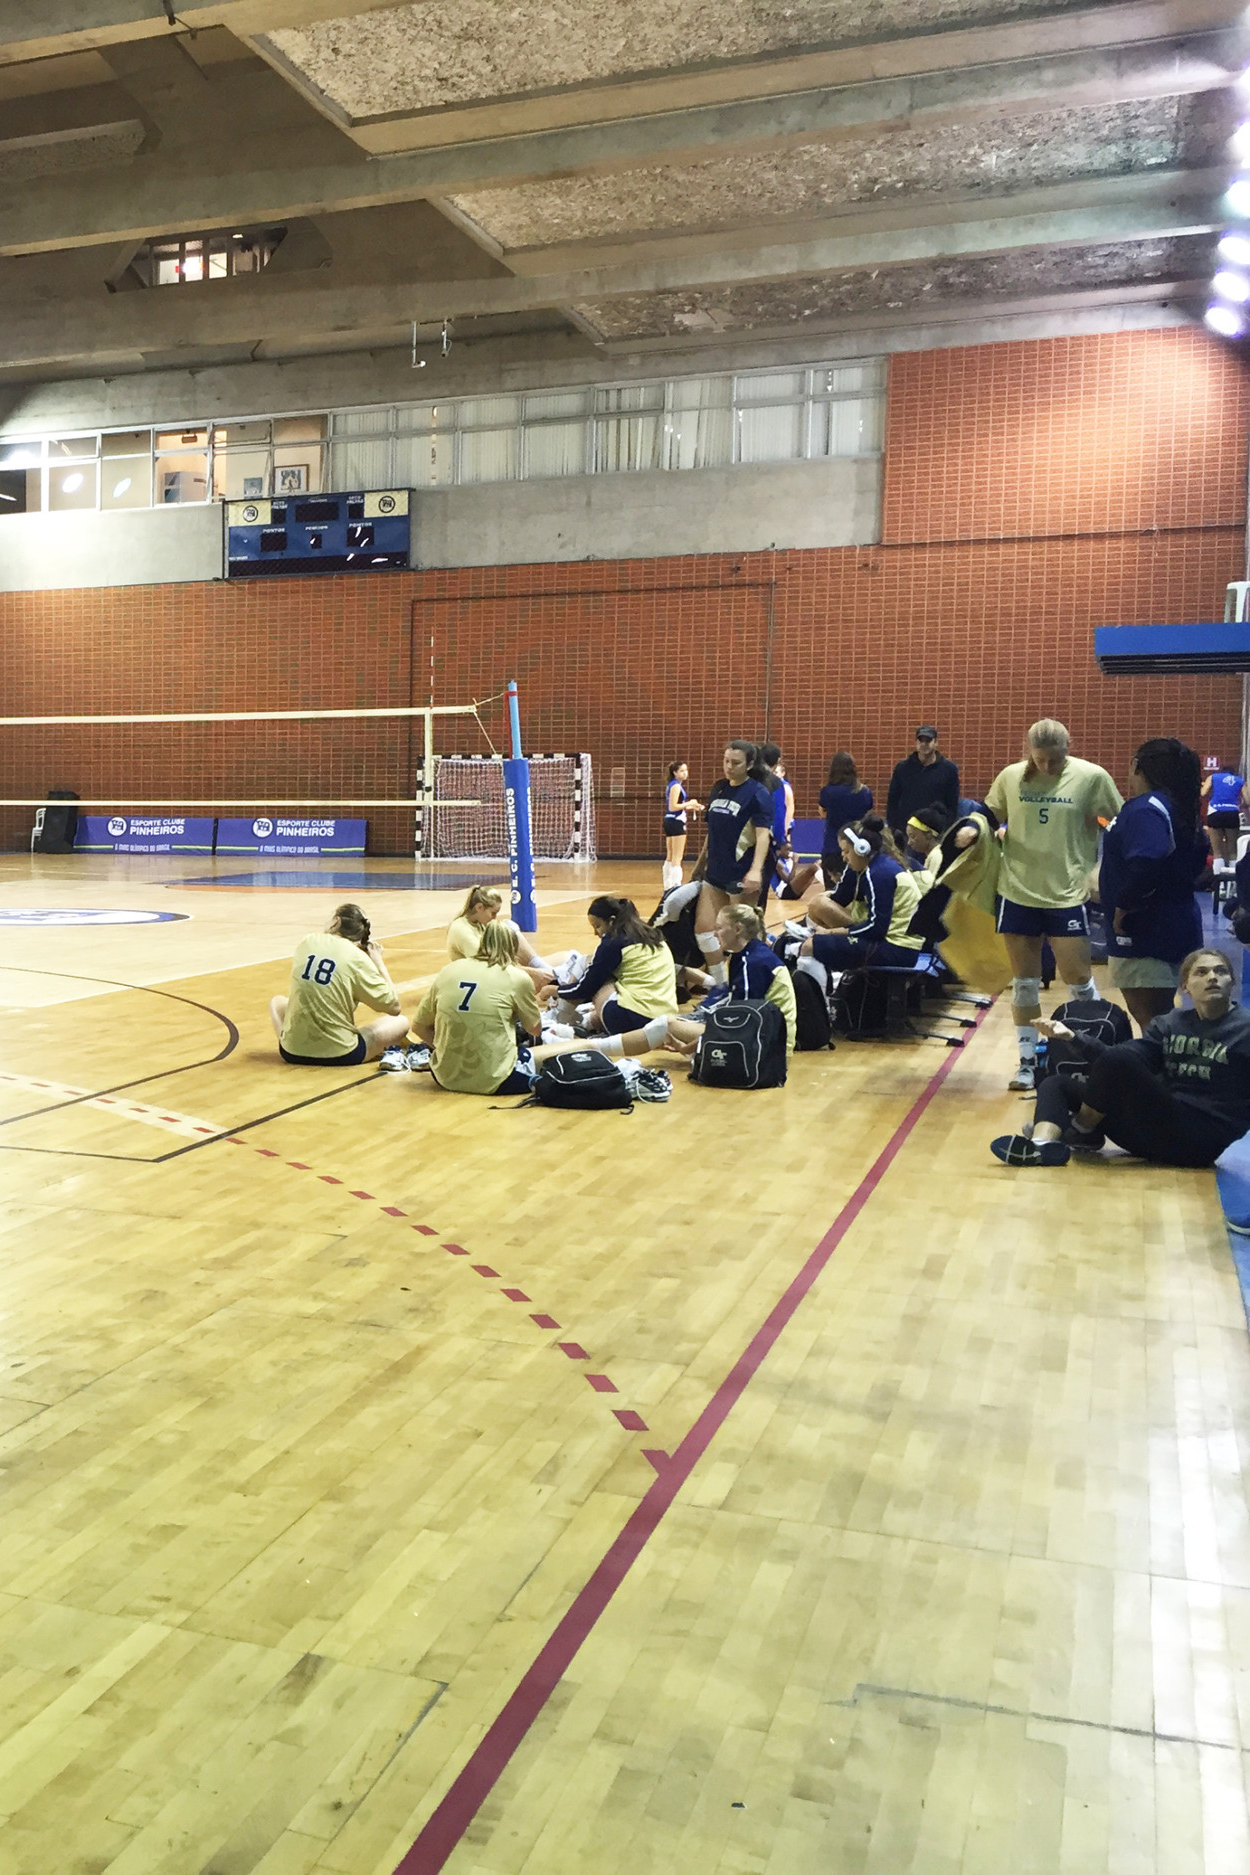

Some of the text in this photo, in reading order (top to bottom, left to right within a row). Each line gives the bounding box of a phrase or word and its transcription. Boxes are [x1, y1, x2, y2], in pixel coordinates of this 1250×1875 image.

[1019, 796, 1075, 804] VOLLEYBALL
[130, 818, 186, 827] ESPORTE CLUBE
[505, 787, 518, 857] PINHEIROS
[1039, 808, 1049, 824] 5
[130, 826, 185, 836] PINHEIROS
[276, 827, 335, 837] PINHEIROS
[301, 954, 336, 986] 18
[457, 981, 478, 1012] 7
